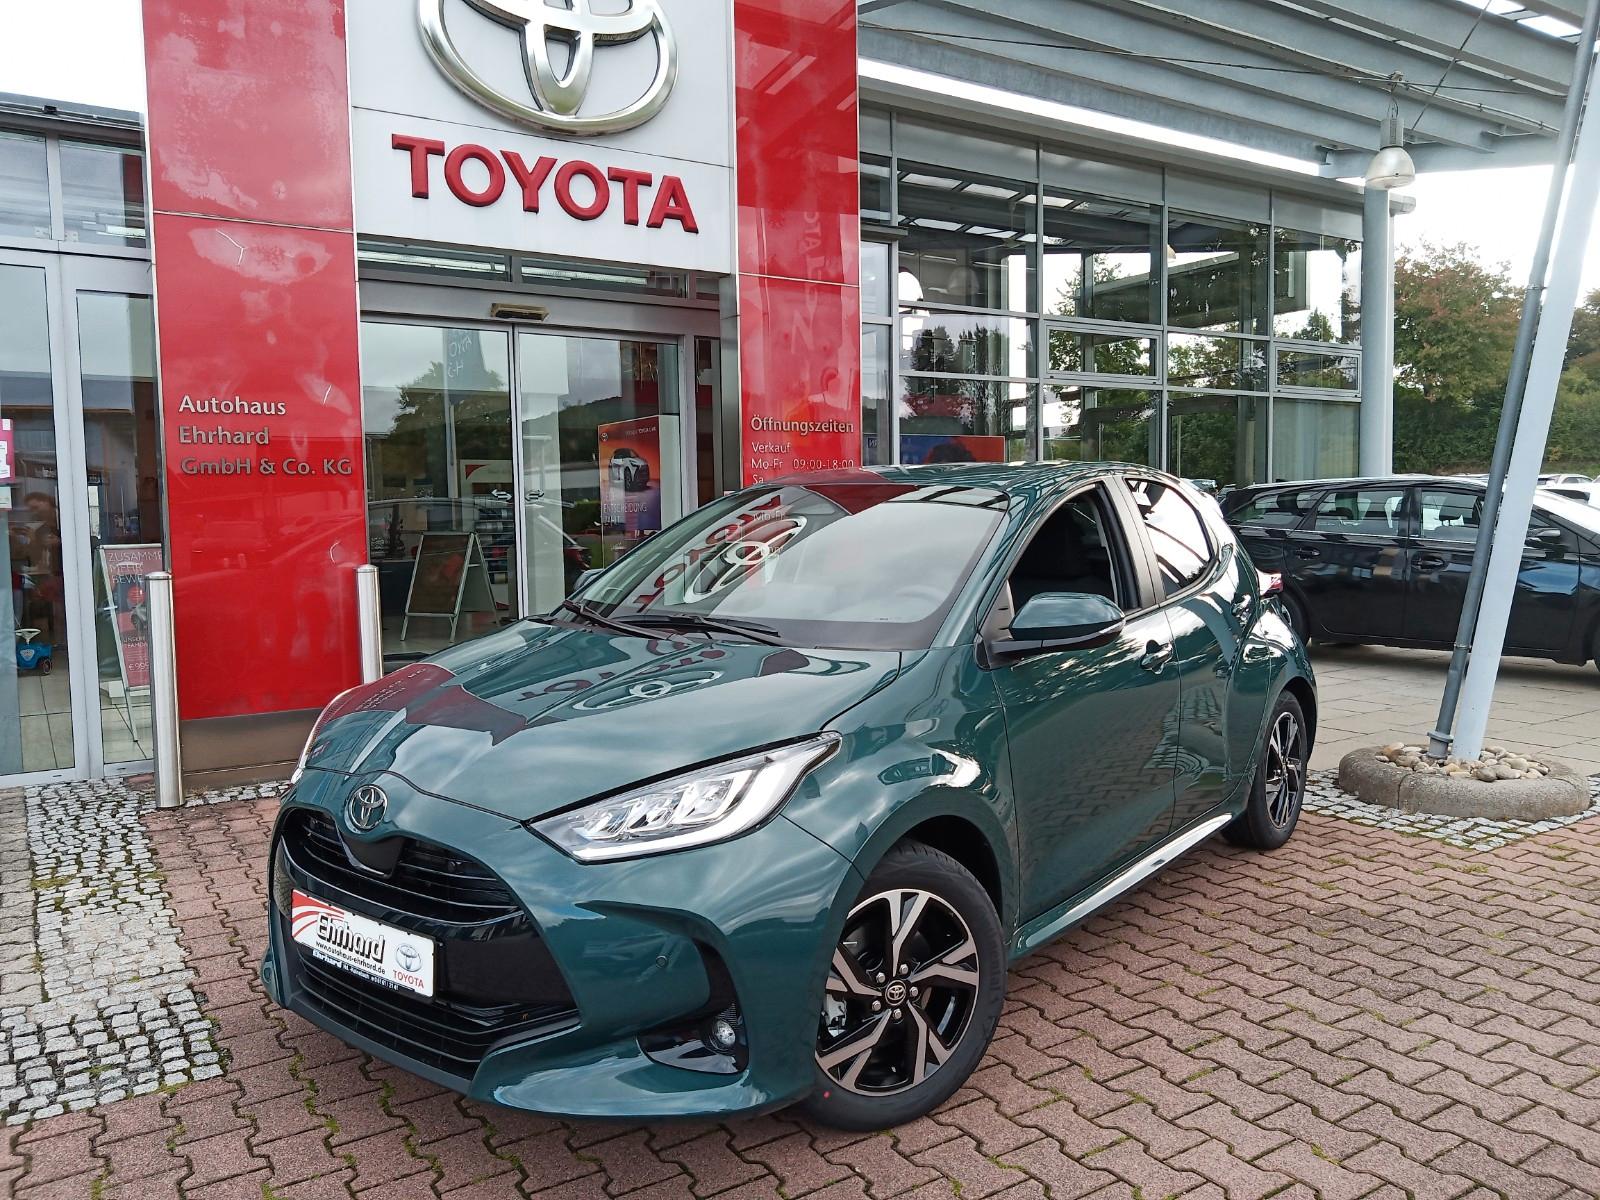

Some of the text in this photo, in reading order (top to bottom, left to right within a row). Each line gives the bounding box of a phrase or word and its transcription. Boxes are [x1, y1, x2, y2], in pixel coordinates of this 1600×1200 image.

[392, 133, 699, 234] TOYOTA
[178, 395, 287, 417] Autohaus
[751, 414, 855, 436] Öffnungszeiten
[179, 426, 270, 446] Ehrhard
[751, 441, 791, 454] Verkauf
[181, 458, 353, 476] GmbH & Co. KG
[751, 458, 854, 471] Mo-Fr 09:00-18:00
[752, 474, 765, 485] Sa
[316, 912, 386, 965] Ehrhard
[315, 940, 386, 975] www.autohaus-ehrhard.de
[392, 969, 425, 989] TOYOTA
